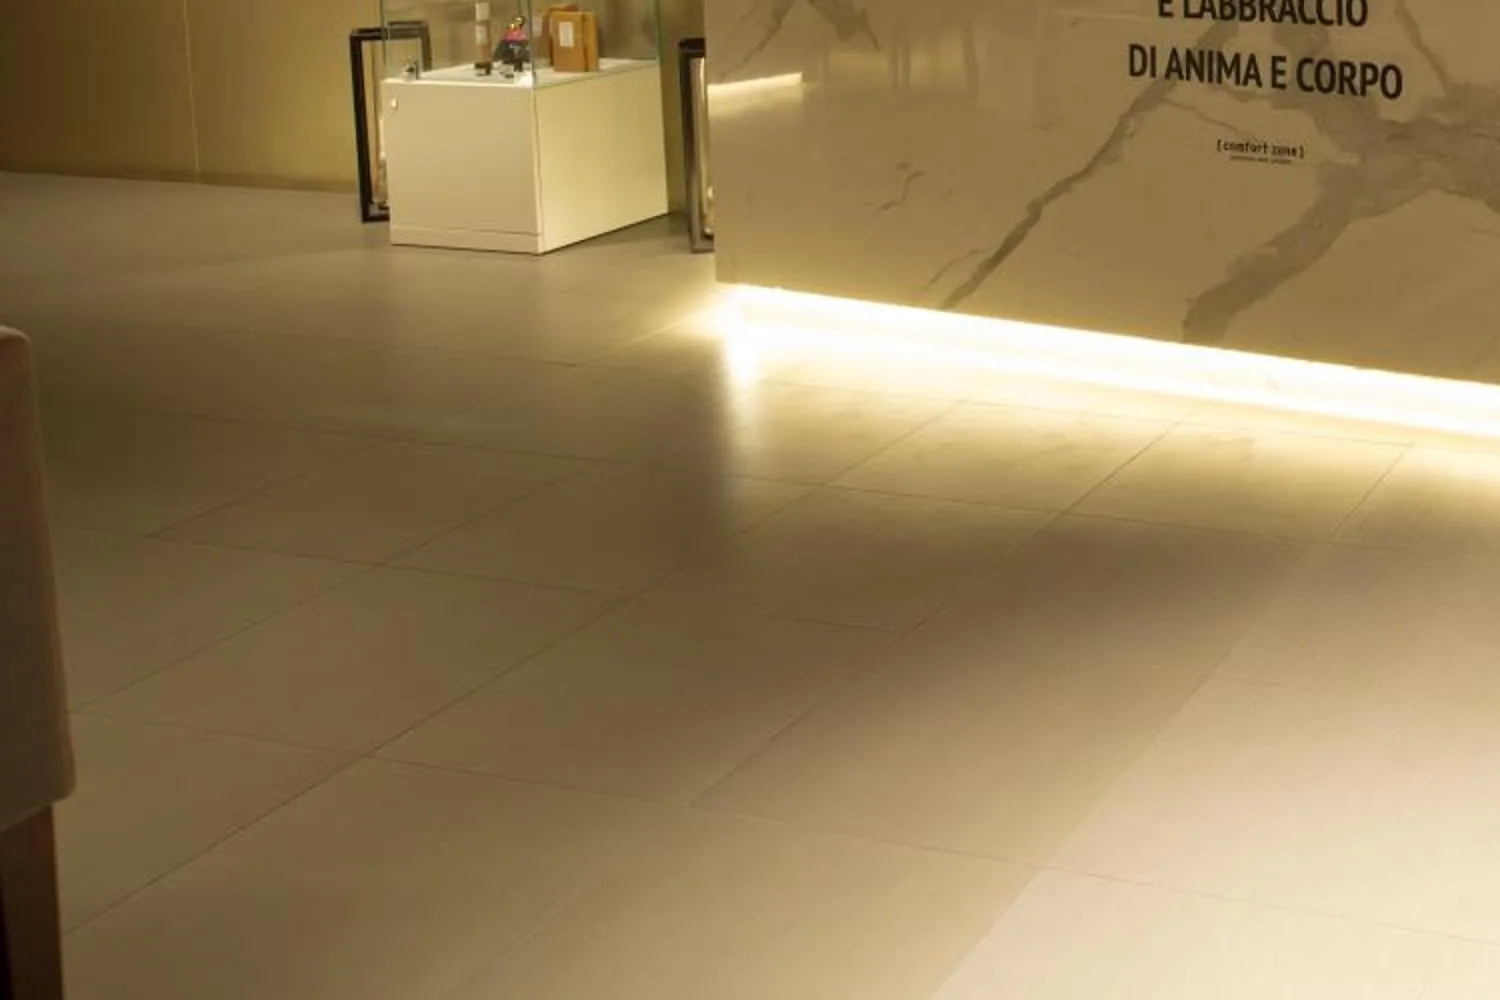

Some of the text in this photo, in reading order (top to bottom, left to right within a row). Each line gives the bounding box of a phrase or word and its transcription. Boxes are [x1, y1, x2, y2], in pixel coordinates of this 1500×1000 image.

[1128, 43, 1404, 100] DI ANIMA E CORPO
